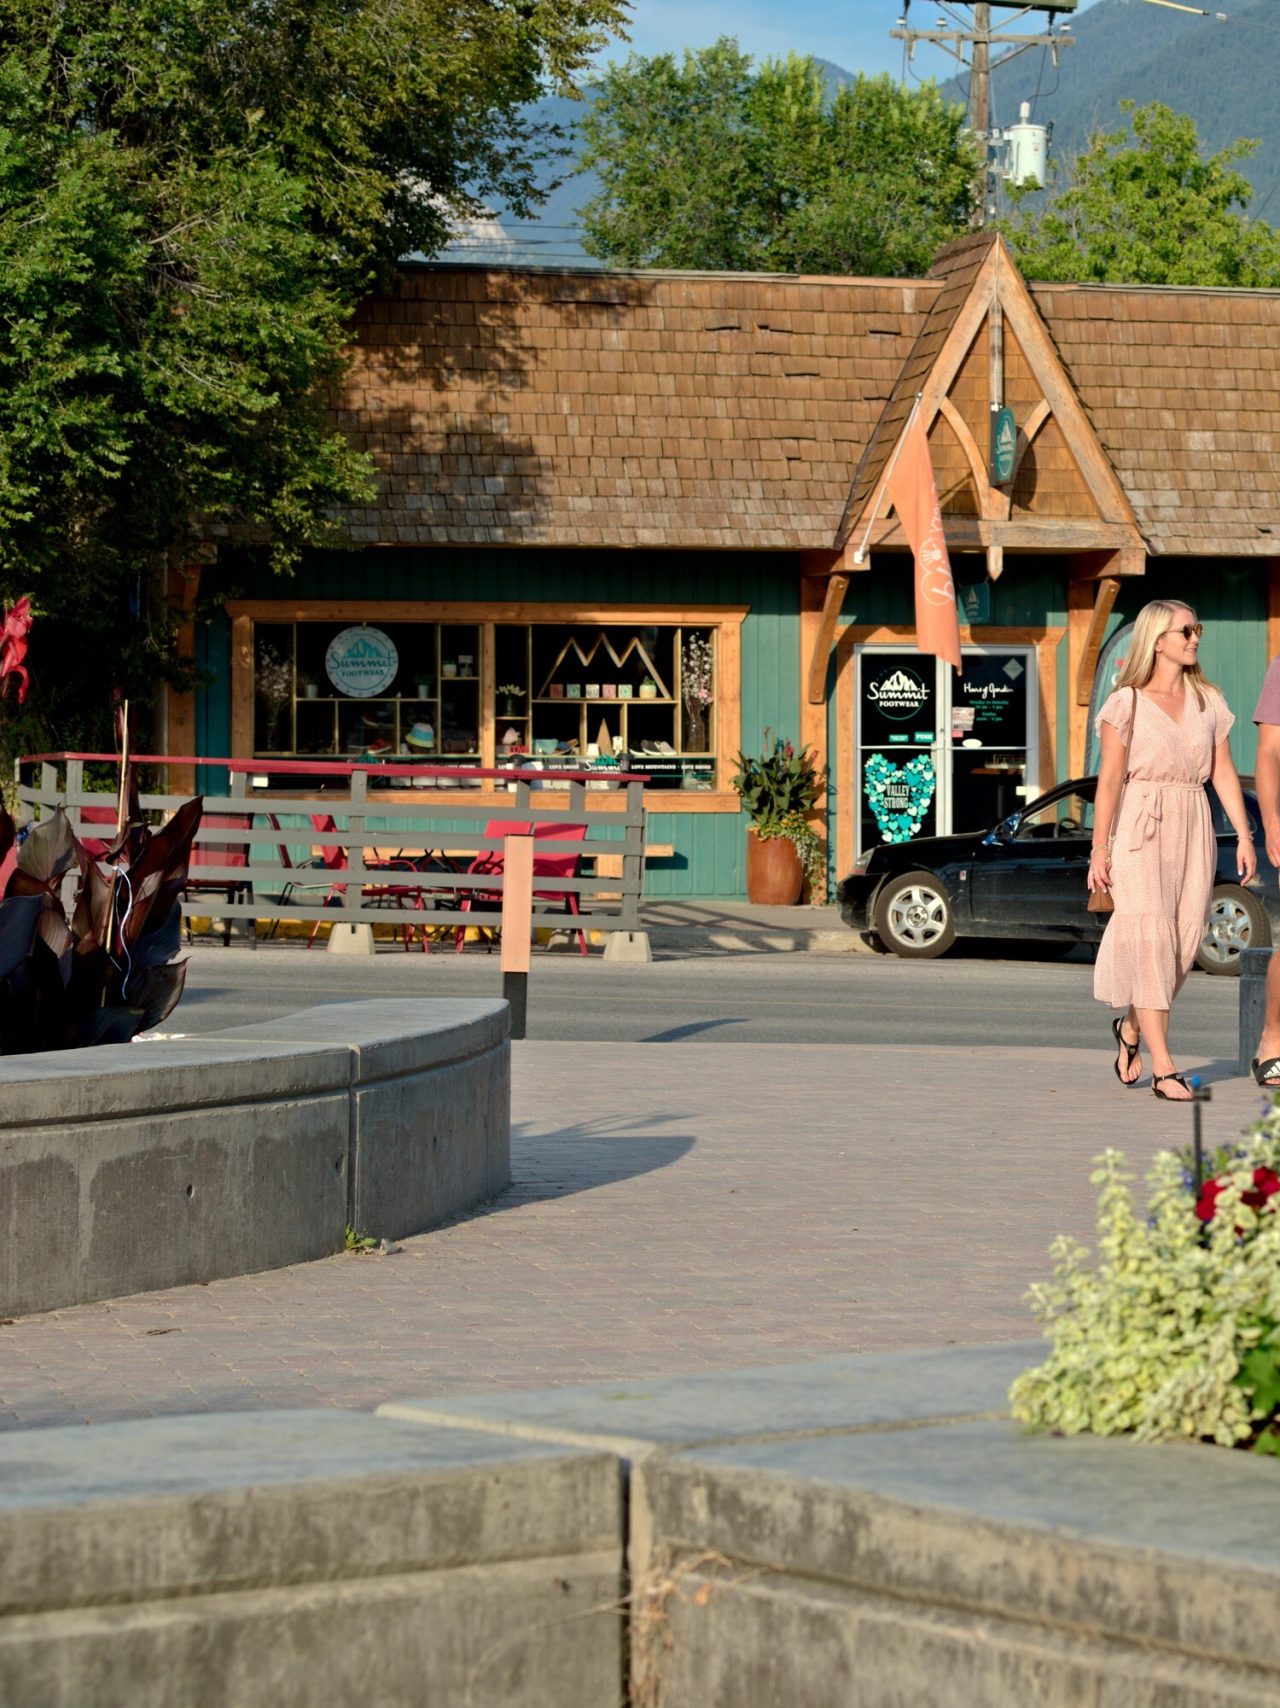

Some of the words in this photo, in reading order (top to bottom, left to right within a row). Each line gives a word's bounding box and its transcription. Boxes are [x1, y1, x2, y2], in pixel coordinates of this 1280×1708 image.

[327, 649, 395, 670] Summit
[866, 681, 931, 700] Summit
[879, 700, 920, 708] FOOTWEAR
[584, 759, 620, 773] Summi
[886, 784, 909, 797] VALLEY
[884, 797, 908, 809] STRONG
